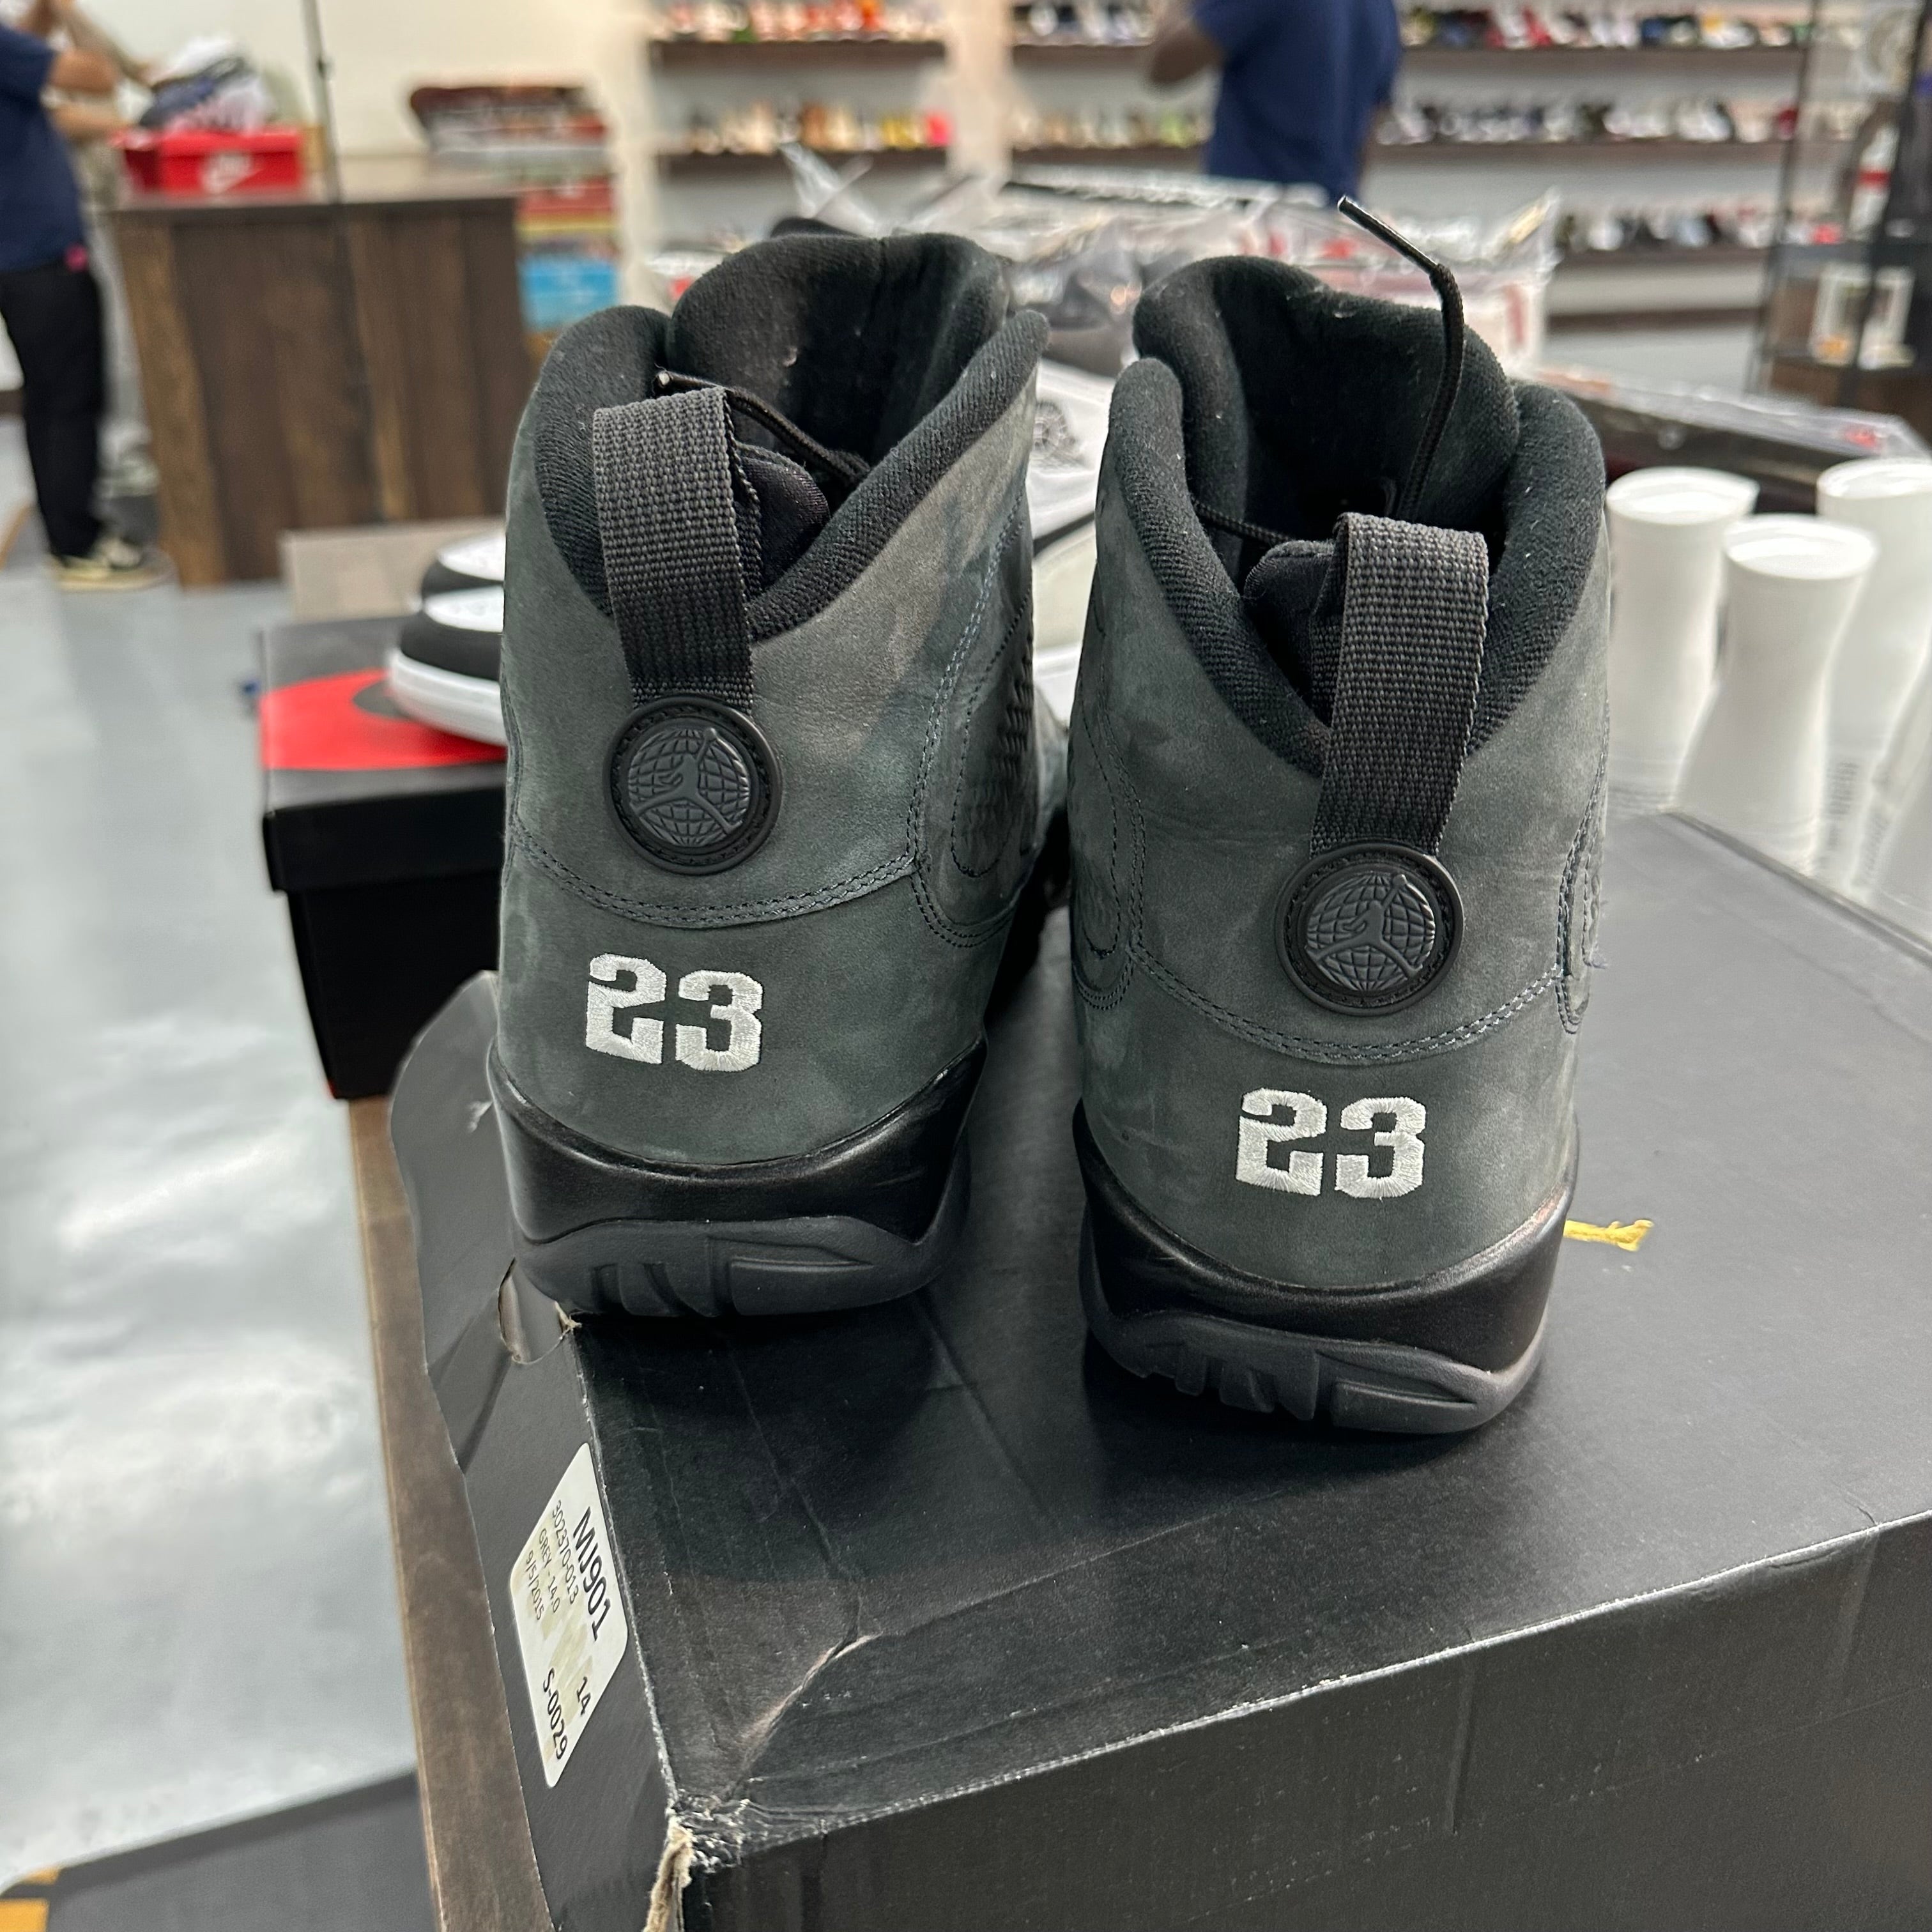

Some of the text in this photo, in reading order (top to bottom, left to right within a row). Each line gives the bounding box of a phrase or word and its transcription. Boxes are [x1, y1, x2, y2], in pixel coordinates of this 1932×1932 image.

[586, 953, 763, 1072] 23
[1236, 1087, 1426, 1199] 23
[525, 1550, 544, 1621] 9/5/2015
[539, 1528, 552, 1568] GREY
[548, 1575, 560, 1614] 14.0
[552, 1499, 579, 1604] 302370-013
[572, 1506, 611, 1641] MJ901
[542, 1667, 568, 1760] S-0029
[576, 1676, 591, 1715] 14
